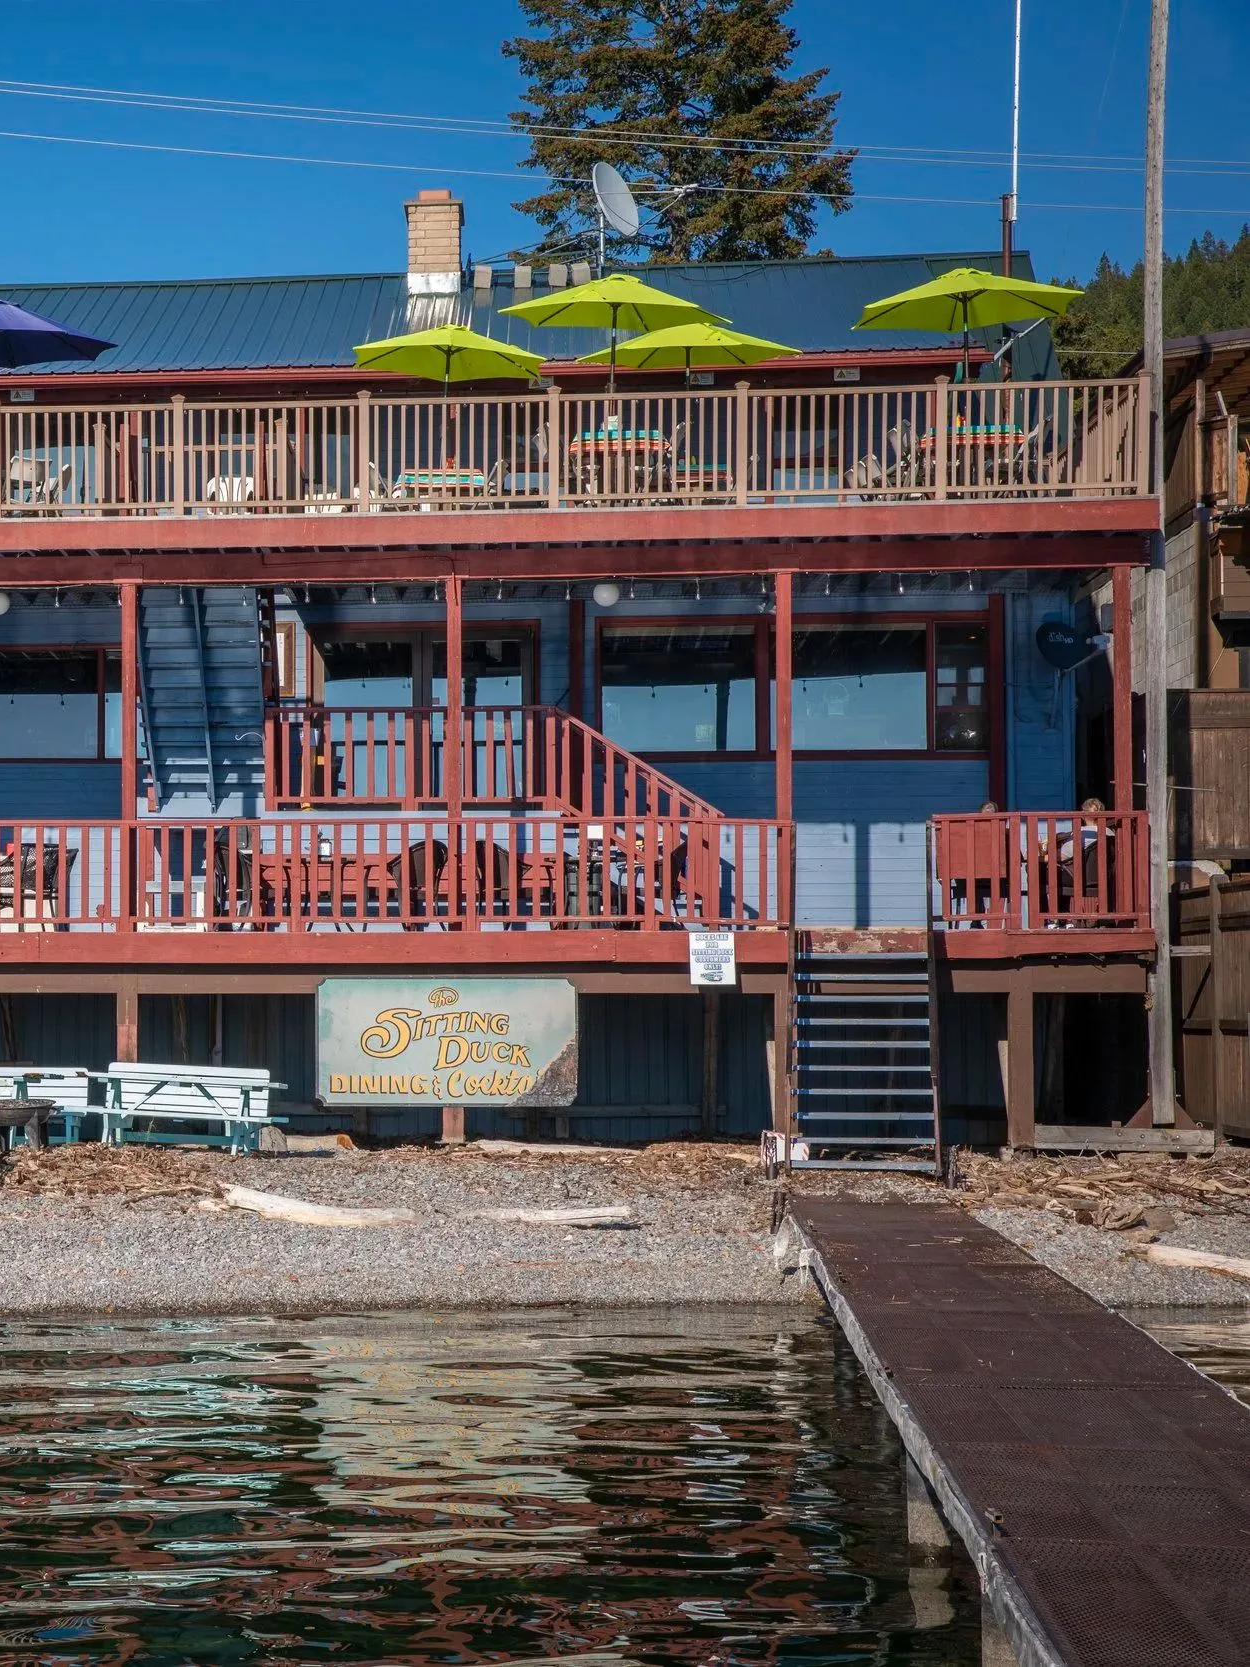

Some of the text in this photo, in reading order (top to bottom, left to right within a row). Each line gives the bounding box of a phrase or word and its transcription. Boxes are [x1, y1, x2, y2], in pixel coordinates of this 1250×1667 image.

[360, 1007, 510, 1059] SITTING
[433, 1035, 532, 1072] DUCK
[329, 1073, 428, 1095] DINING
[432, 1074, 443, 1100] &
